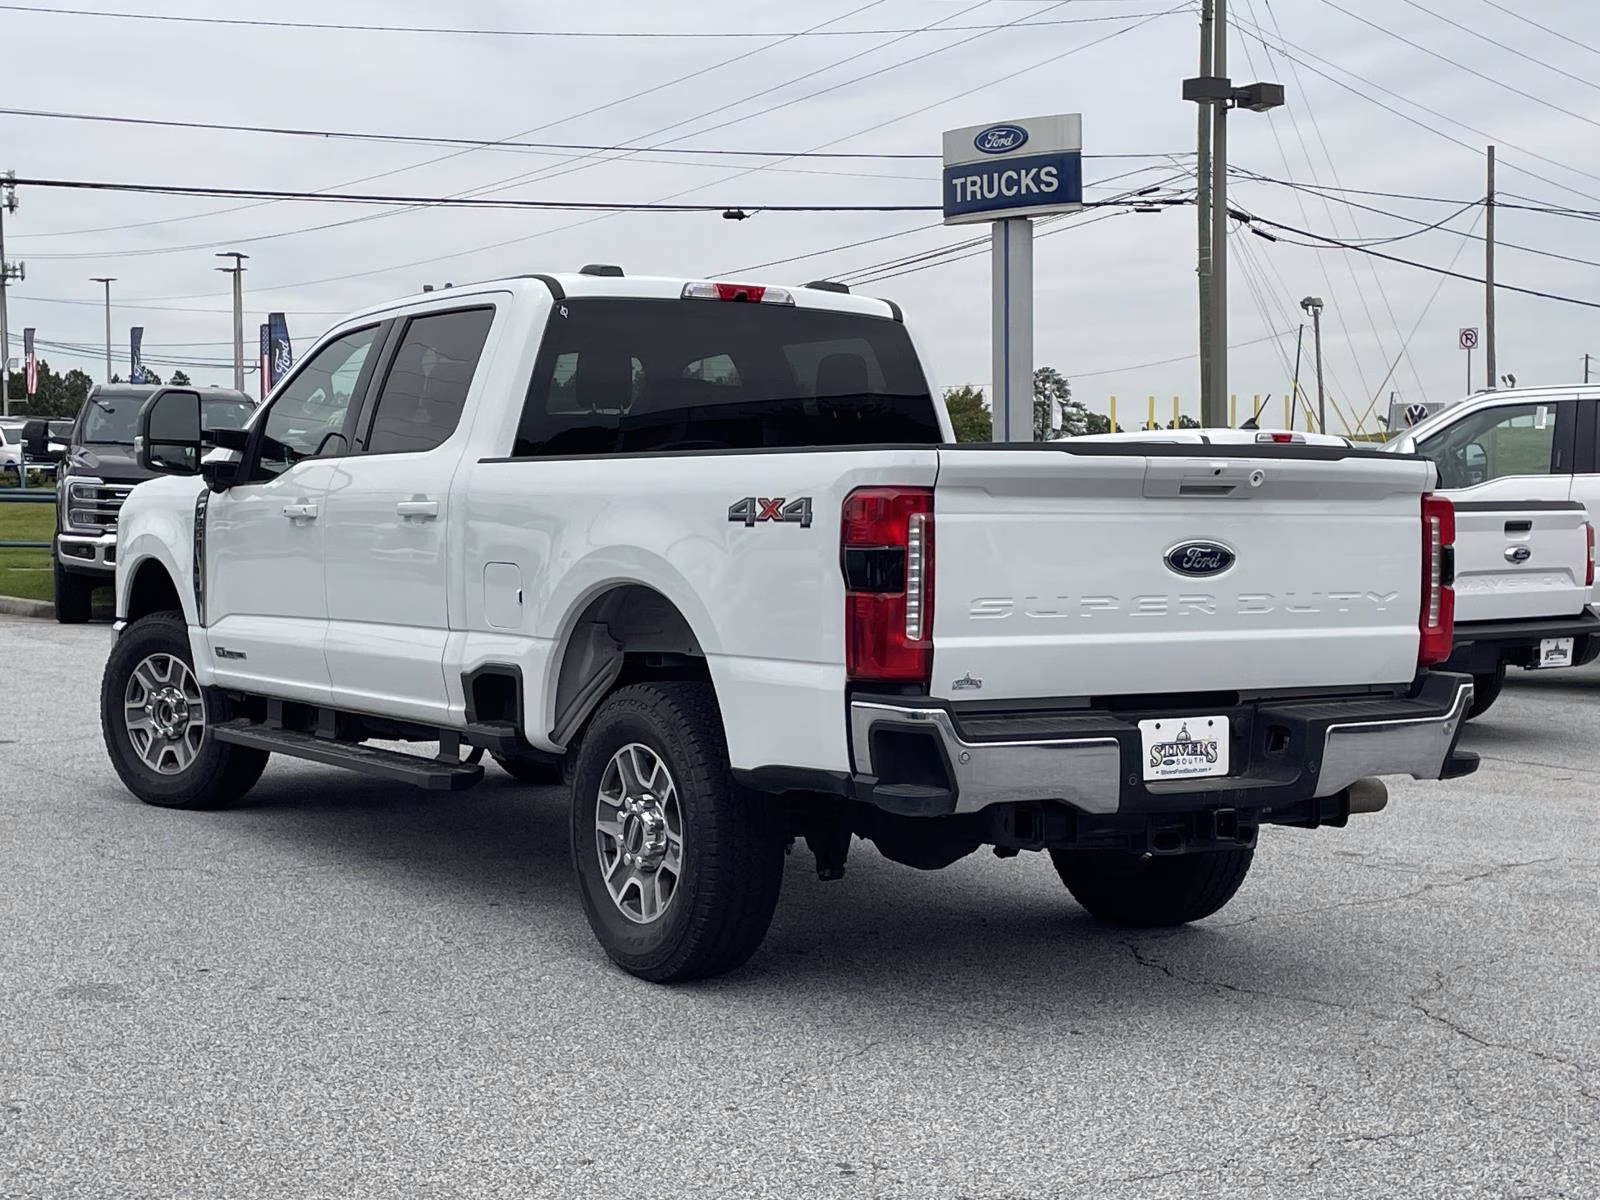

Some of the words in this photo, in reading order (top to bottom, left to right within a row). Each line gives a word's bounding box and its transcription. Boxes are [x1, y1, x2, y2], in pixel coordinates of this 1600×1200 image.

[984, 130, 1014, 148] Ford
[951, 165, 1059, 203] TRUCKS
[274, 338, 290, 373] Ford
[1183, 547, 1221, 569] Ford
[969, 593, 1217, 619] SUPER
[1237, 591, 1399, 615] DUTY
[1150, 741, 1218, 768] STIVERS
[1176, 757, 1204, 766] SOUTH
